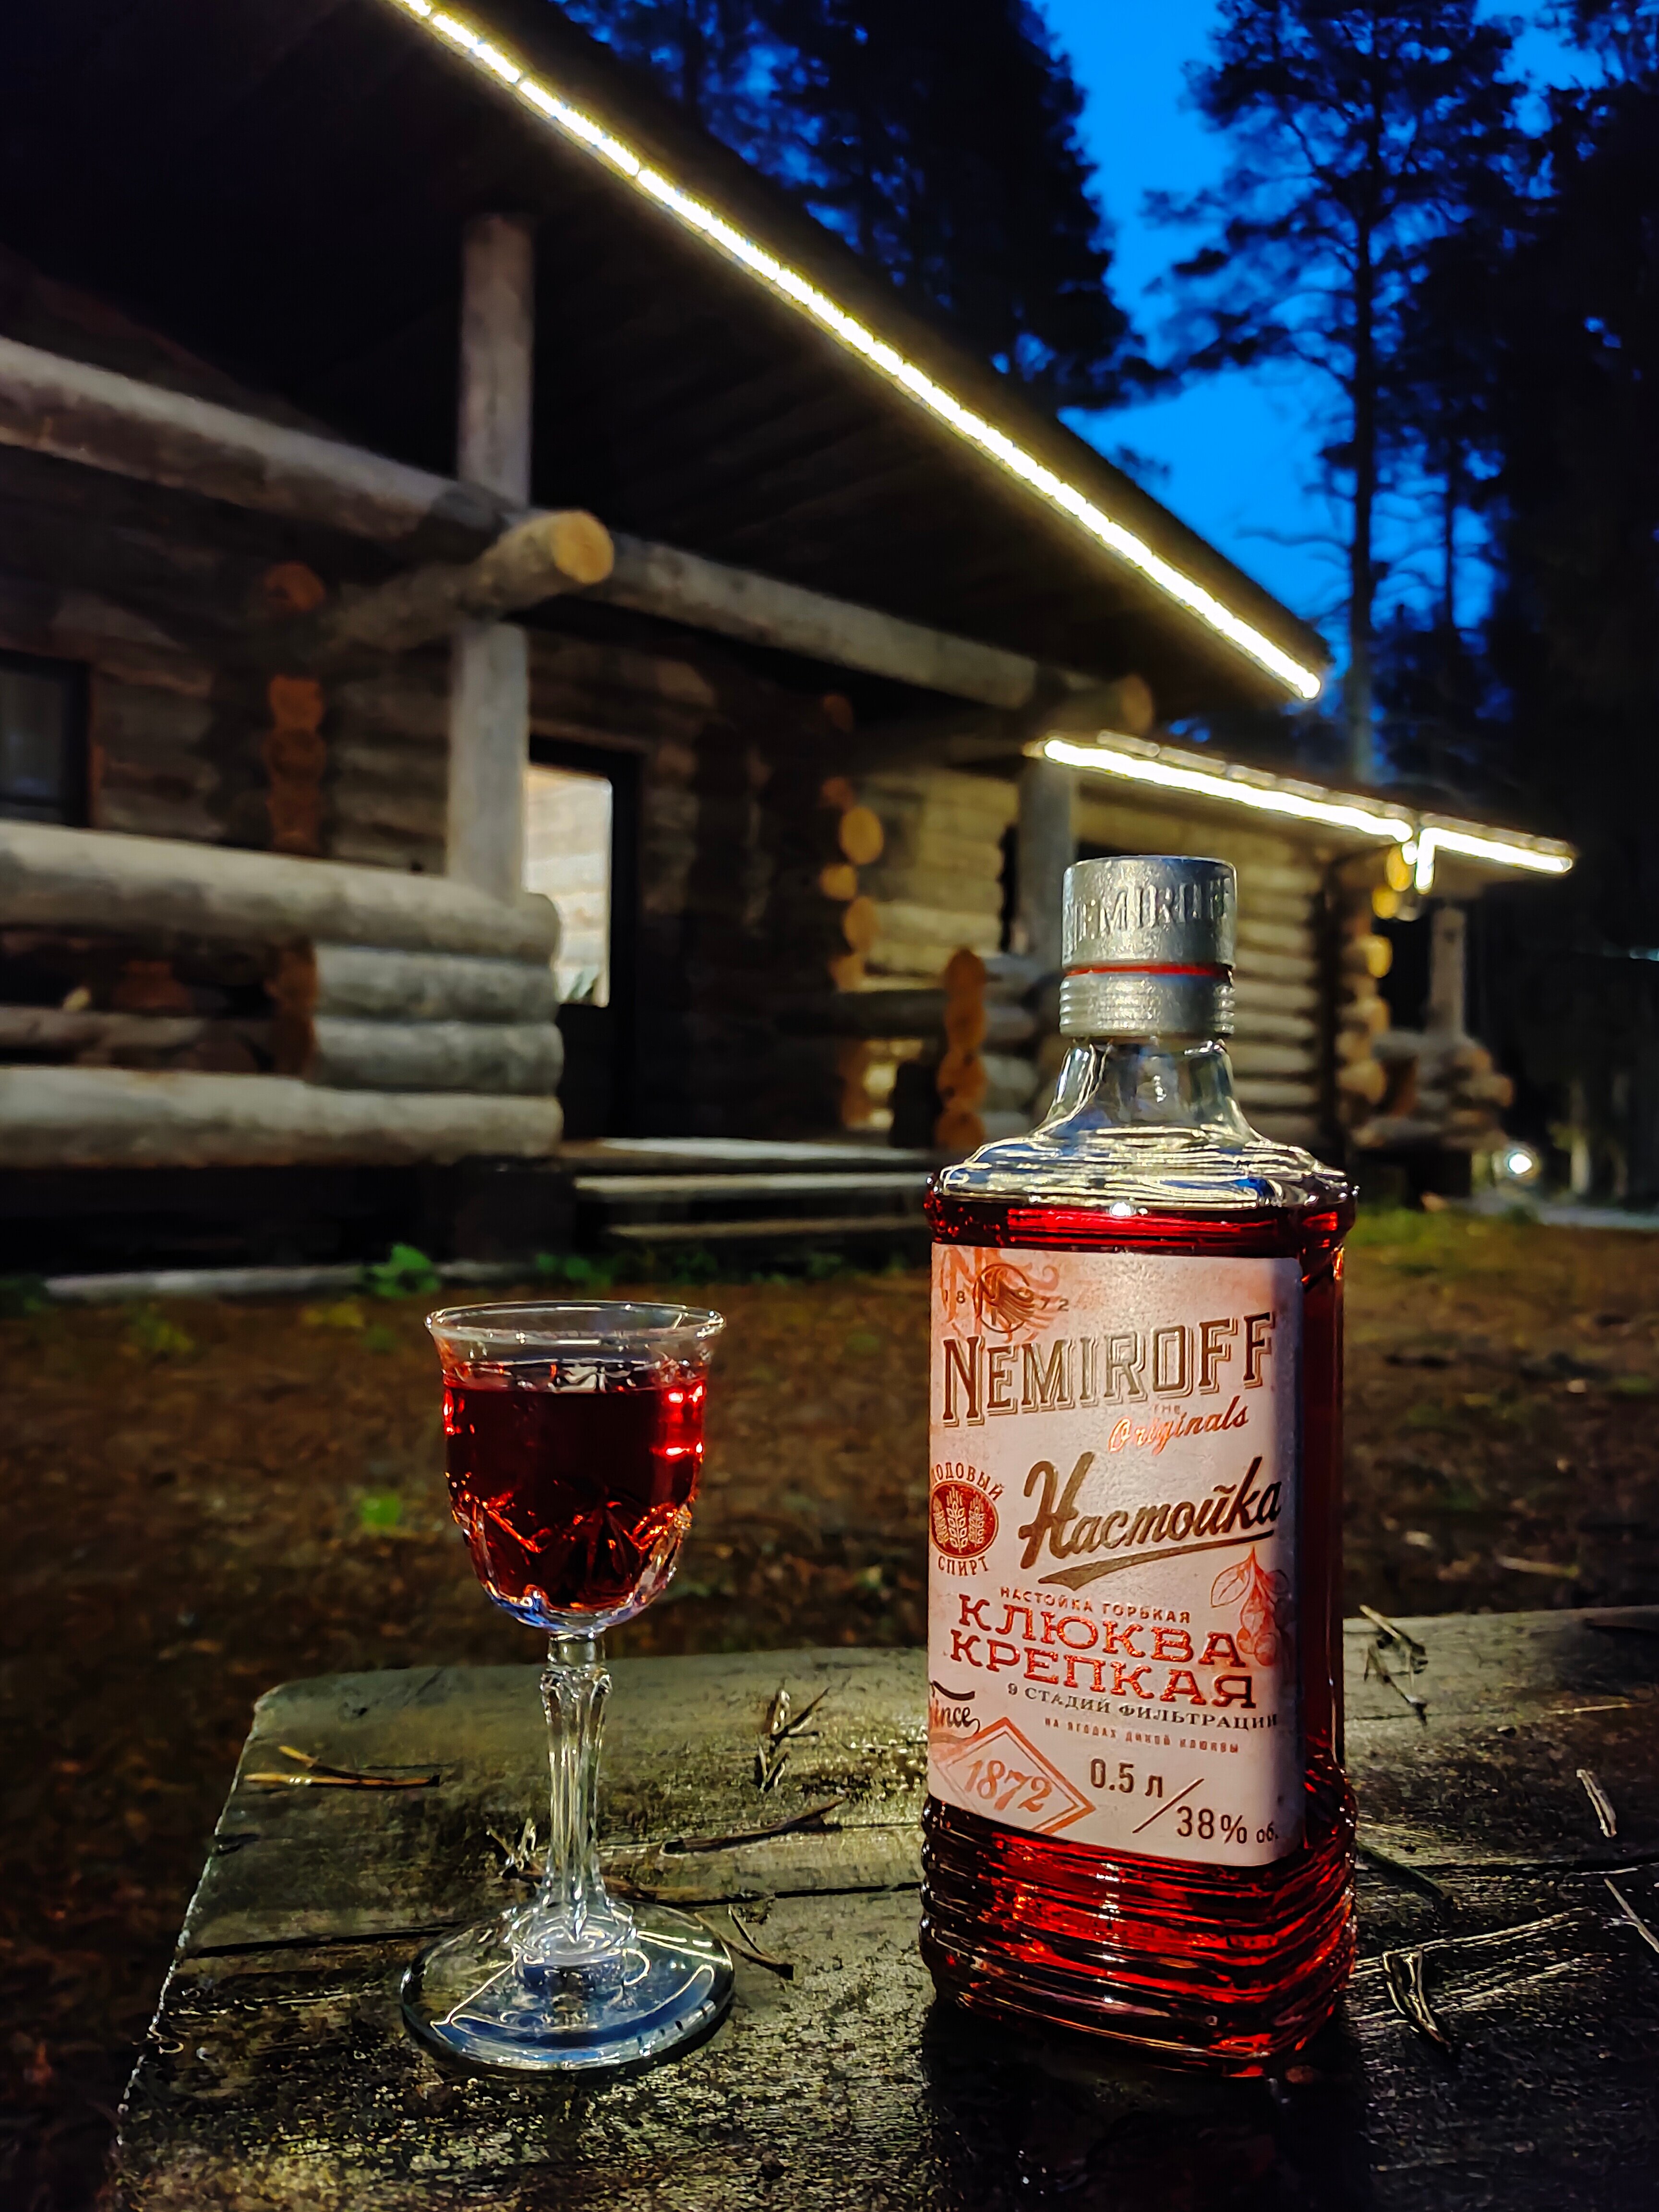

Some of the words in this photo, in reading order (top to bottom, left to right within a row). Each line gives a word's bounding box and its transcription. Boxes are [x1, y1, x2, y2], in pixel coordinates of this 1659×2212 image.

[942, 1312, 1276, 1427] NEMIROFF
[1108, 1395, 1249, 1455] Originals
[1018, 1451, 1282, 1570] Настойка
[938, 1555, 989, 1576] СПИРТ
[959, 1593, 1247, 1668] КЛЮКВА
[1000, 1586, 1093, 1613] НАСТОЙКА
[1102, 1602, 1191, 1624] ГОРЬКАЯ
[950, 1628, 1257, 1709] КРЕПКАЯ
[1008, 1682, 1018, 1696] 9
[1024, 1687, 1110, 1714] СТАДИЙ
[1118, 1704, 1278, 1731] ФИЛЬТРАЦИИ
[1045, 1717, 1059, 1728] НА
[964, 1759, 1052, 1813] 1872
[1090, 1758, 1135, 1793] 0.5
[1144, 1775, 1163, 1798] л
[1176, 1805, 1248, 1844] 38%
[1256, 1821, 1280, 1844] об.
